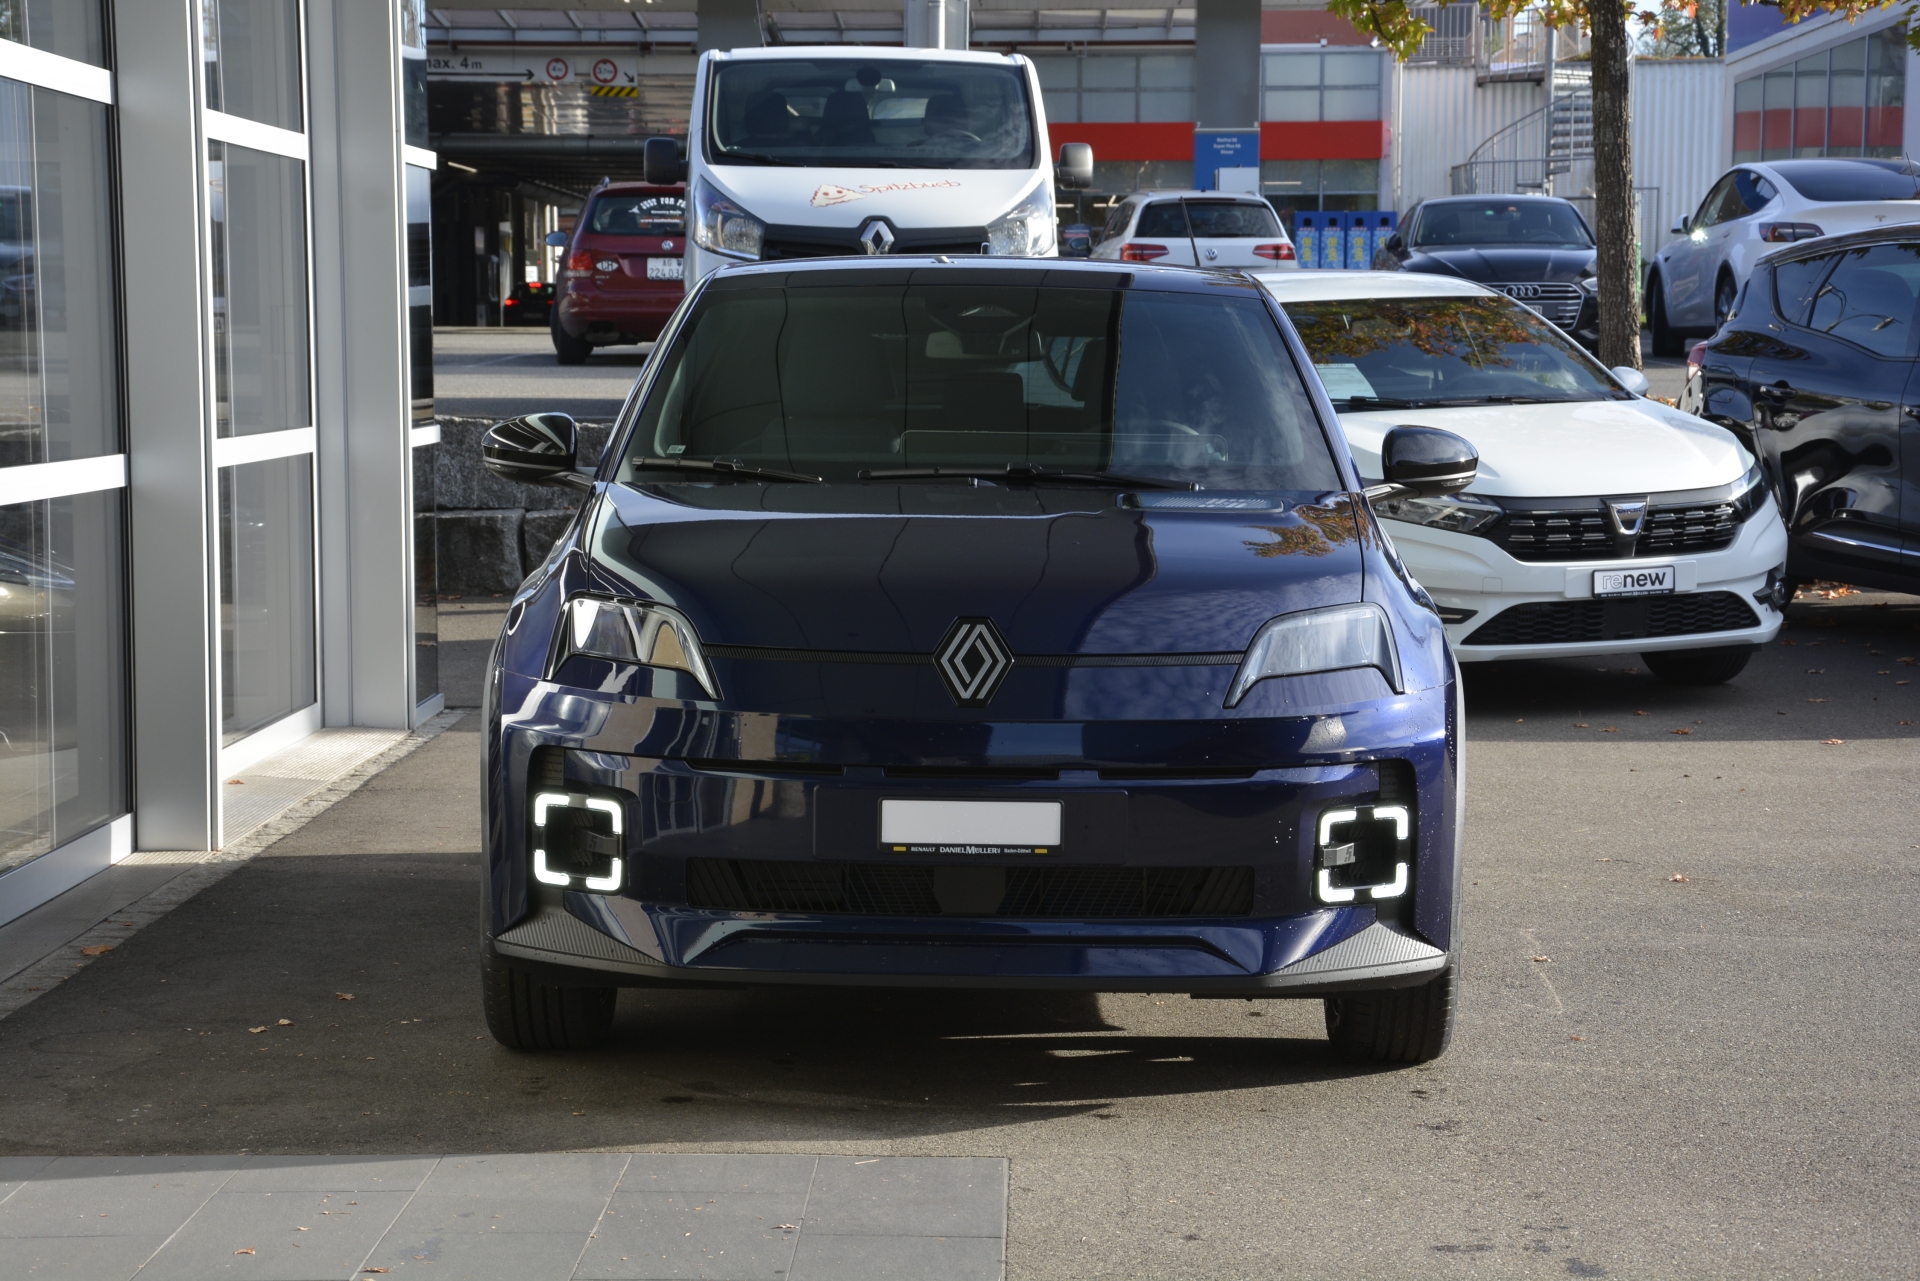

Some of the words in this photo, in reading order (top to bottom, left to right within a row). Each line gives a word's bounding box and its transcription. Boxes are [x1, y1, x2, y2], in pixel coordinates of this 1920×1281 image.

[859, 180, 961, 193] Spitzbueb
[660, 197, 675, 205] FOR
[1603, 572, 1666, 590] renew
